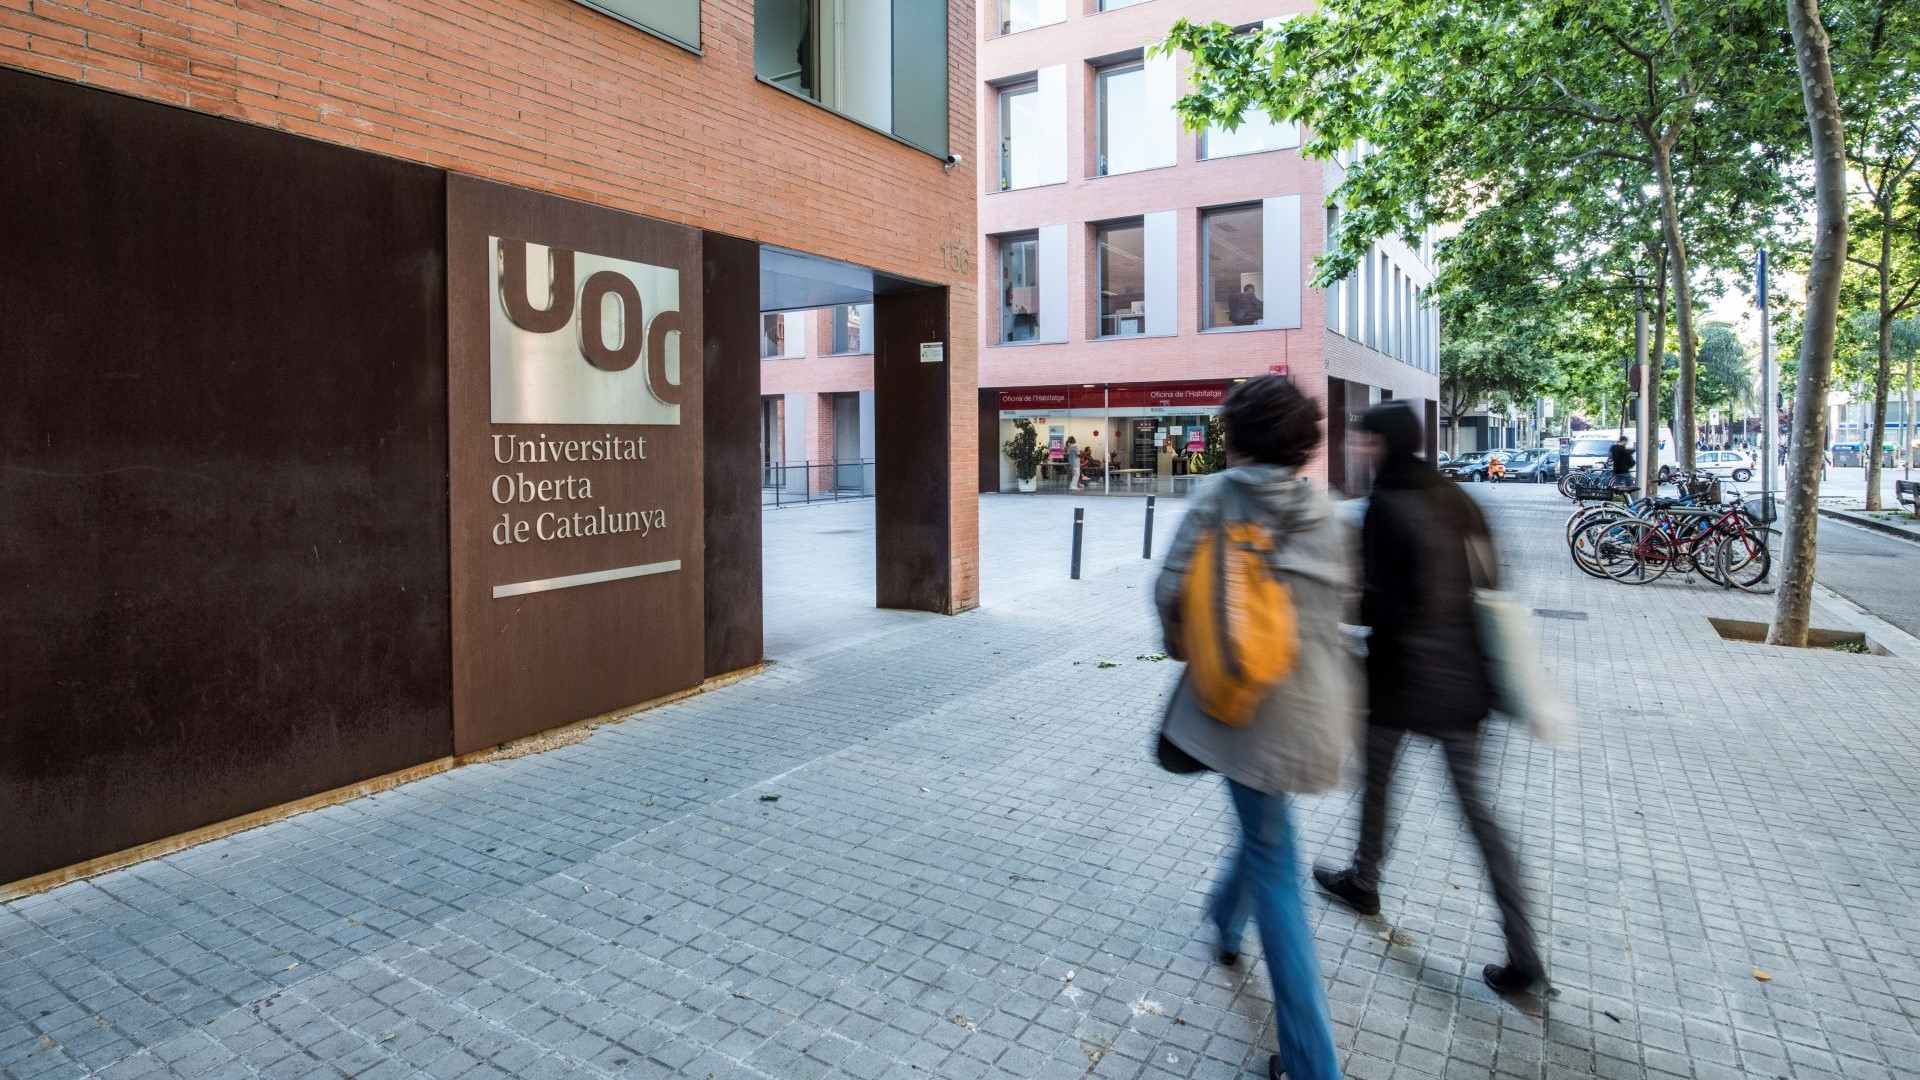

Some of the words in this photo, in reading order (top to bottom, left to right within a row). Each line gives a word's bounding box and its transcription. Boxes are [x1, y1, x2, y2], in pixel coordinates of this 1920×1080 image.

[491, 433, 648, 464] Universitat
[491, 473, 593, 504] Oberta
[492, 514, 531, 546] de
[536, 506, 667, 542] Catalunya
